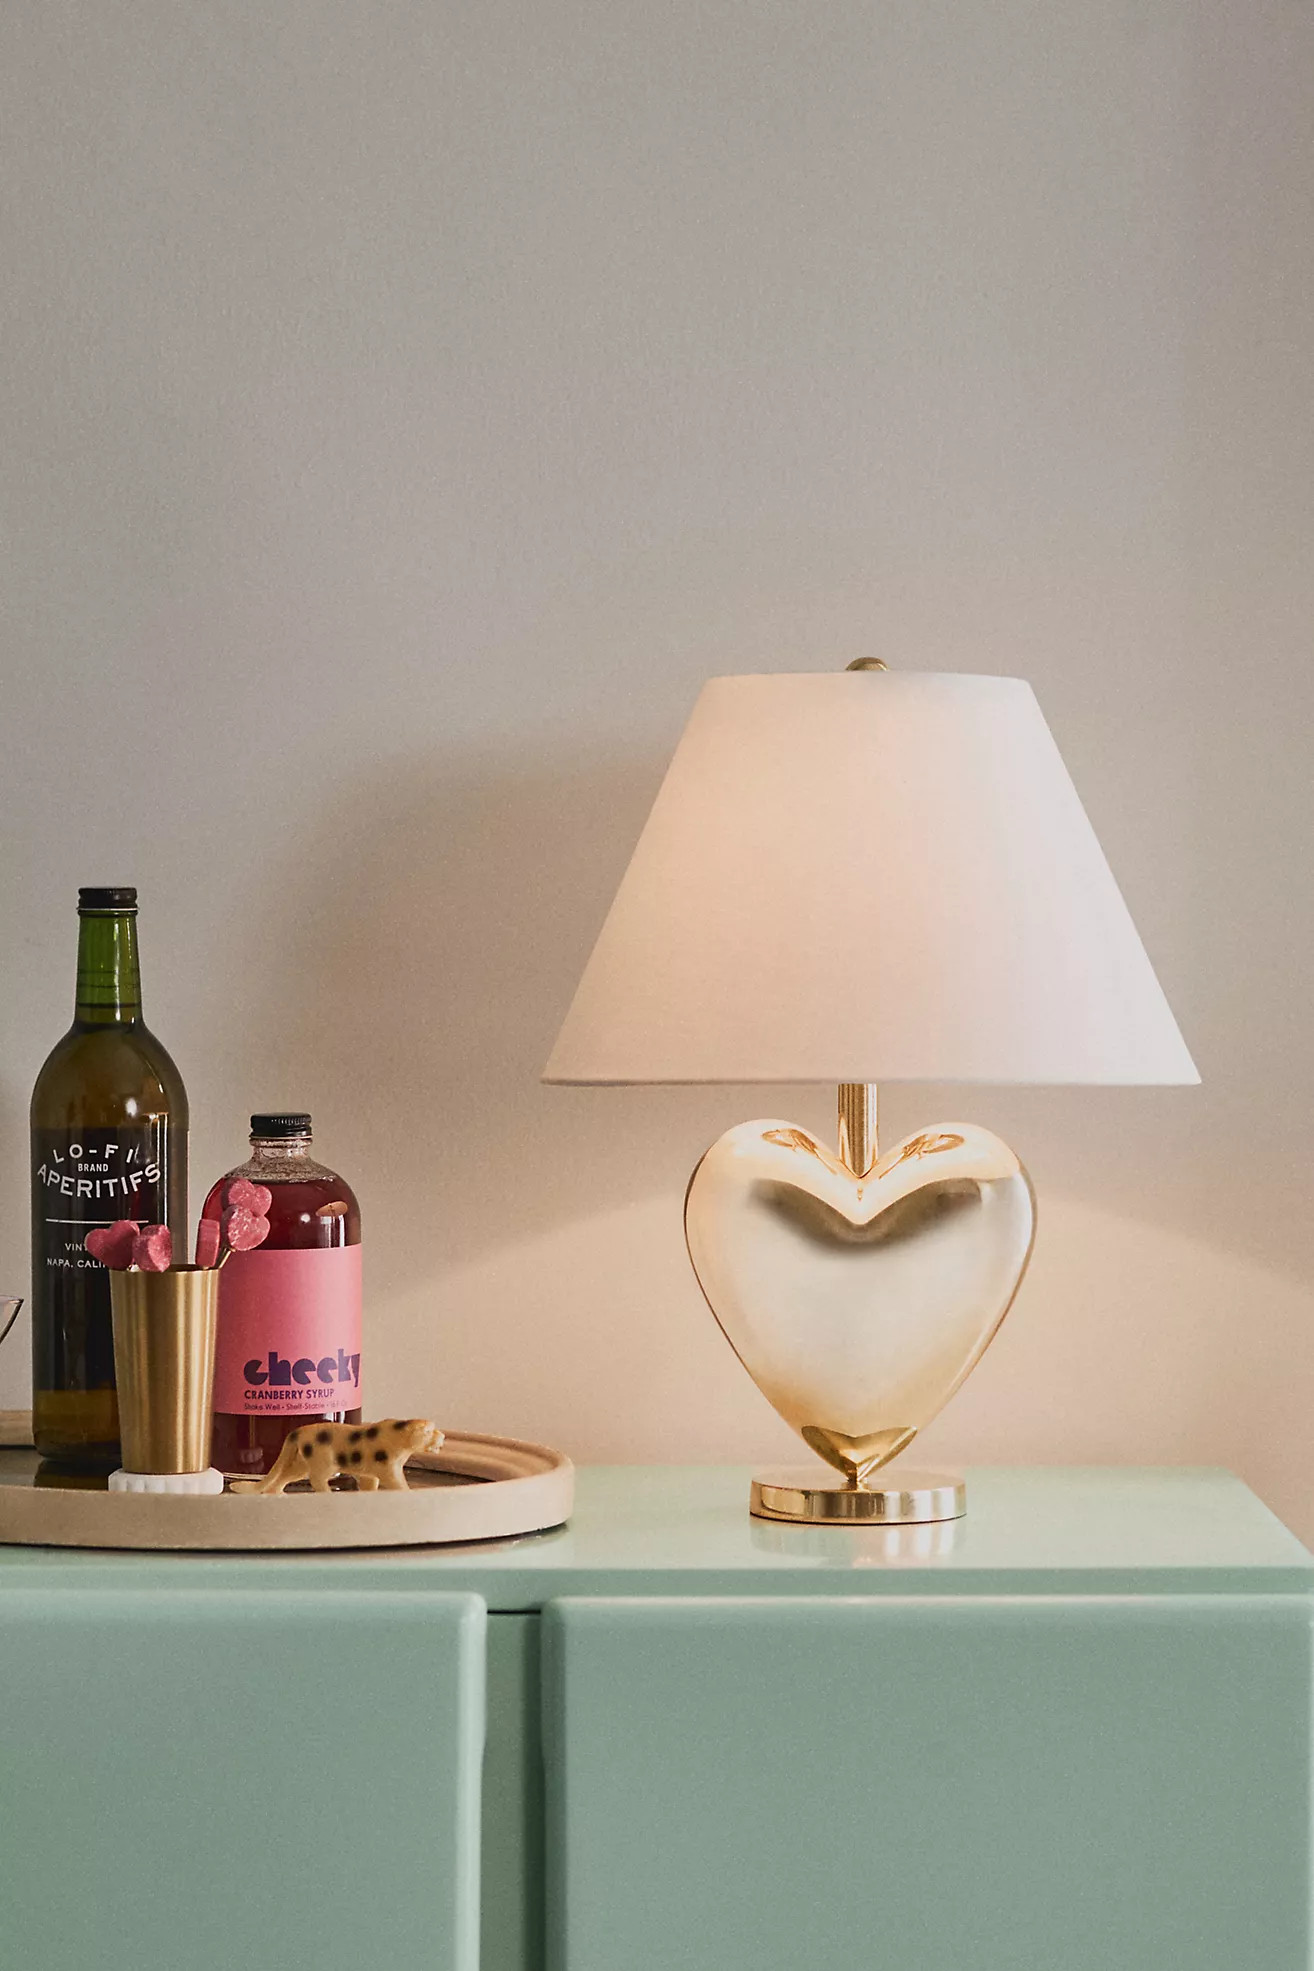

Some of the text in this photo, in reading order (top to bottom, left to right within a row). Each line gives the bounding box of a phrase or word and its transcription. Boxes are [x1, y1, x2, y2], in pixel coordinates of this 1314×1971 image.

[53, 1144, 134, 1164] LO-FI
[77, 1163, 109, 1172] BRAND
[37, 1163, 161, 1198] APERITIFS
[243, 1348, 360, 1388] cheeky
[244, 1388, 335, 1400] CRANBERRY SYRUP
[244, 1403, 263, 1411] Shake
